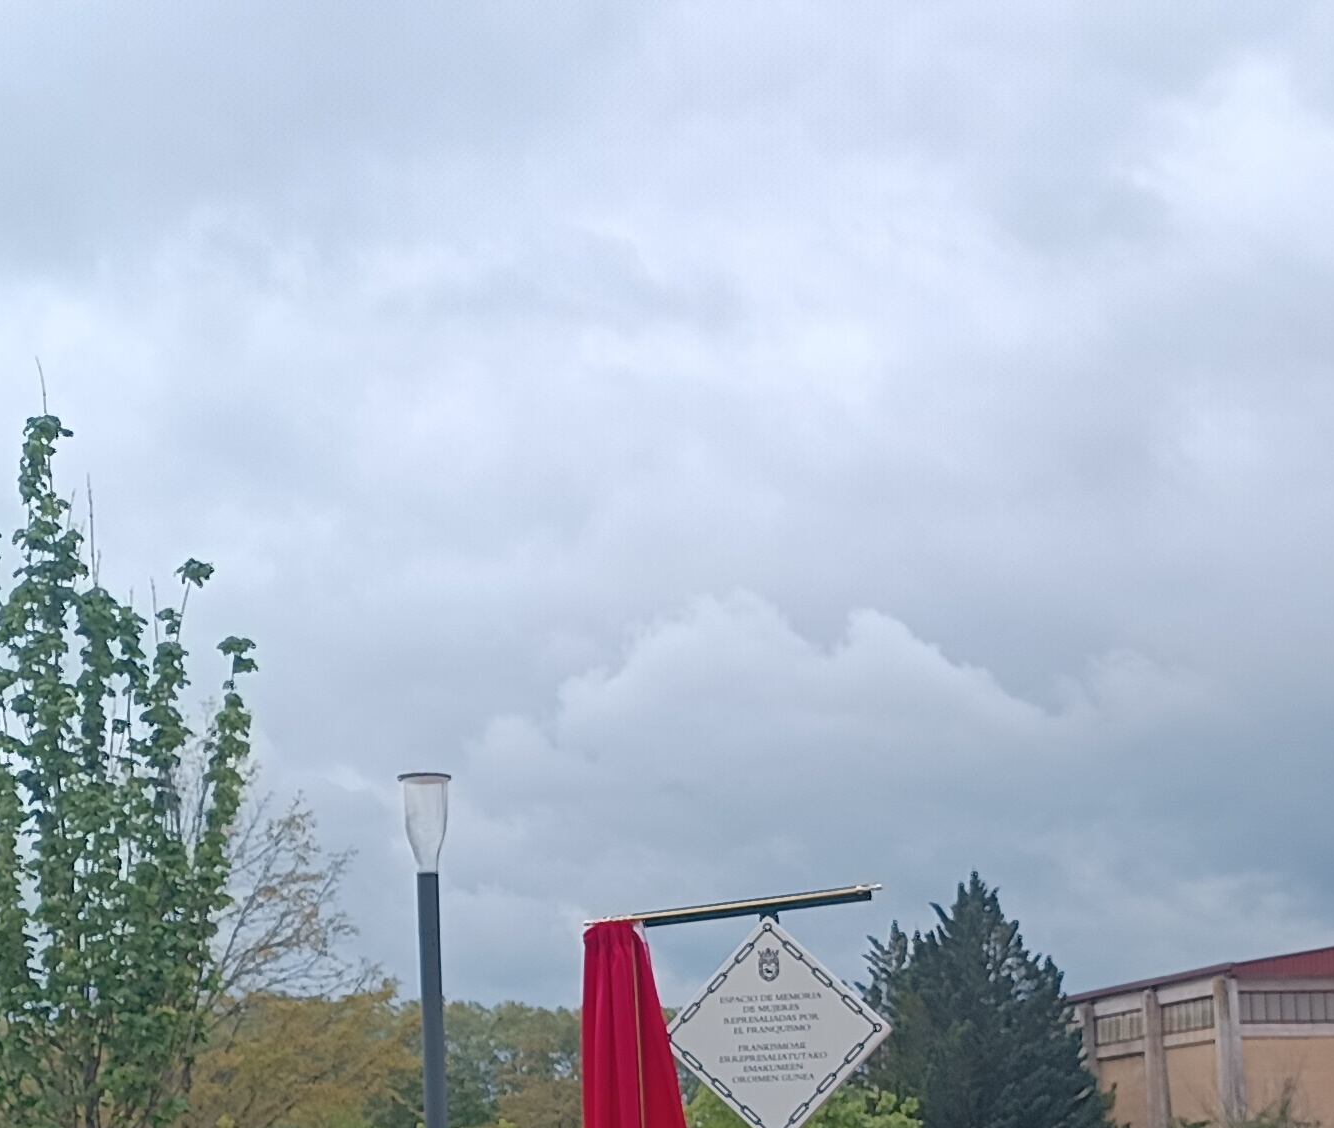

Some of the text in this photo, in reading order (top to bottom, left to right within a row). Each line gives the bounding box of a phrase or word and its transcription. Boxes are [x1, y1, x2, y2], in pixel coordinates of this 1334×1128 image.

[719, 992, 822, 1004] ESPACIO DE MEMORIA
[758, 1004, 800, 1013] MUJERES
[723, 1013, 819, 1025] REPRESALIADAS POR
[733, 1024, 811, 1035] EL FRANQUISMO
